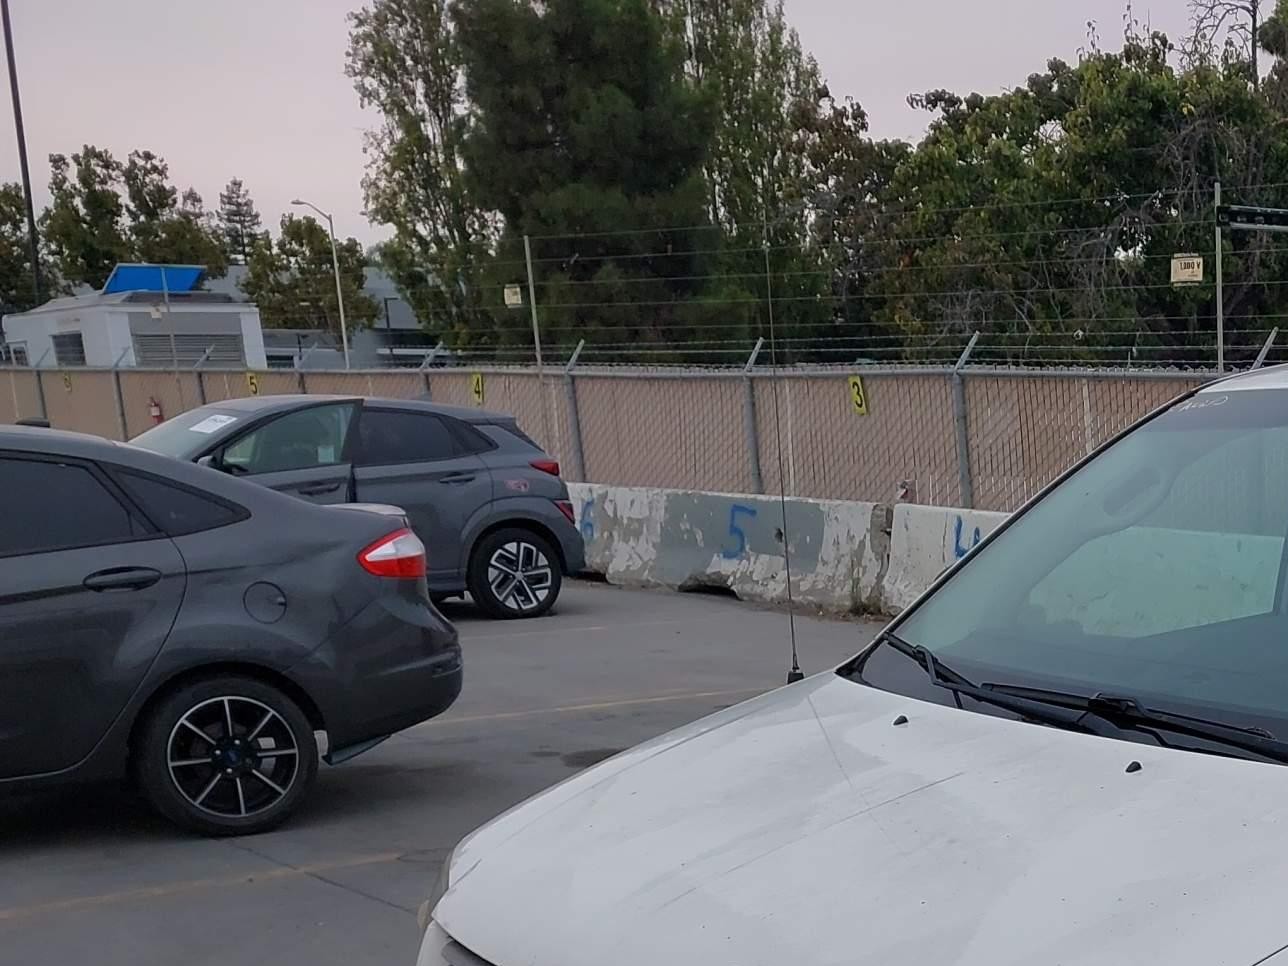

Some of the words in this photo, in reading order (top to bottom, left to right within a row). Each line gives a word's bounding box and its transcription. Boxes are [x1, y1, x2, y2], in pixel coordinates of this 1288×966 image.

[249, 375, 258, 395] 5
[474, 376, 481, 399] 4
[852, 381, 864, 409] 3
[721, 503, 757, 560] 5
